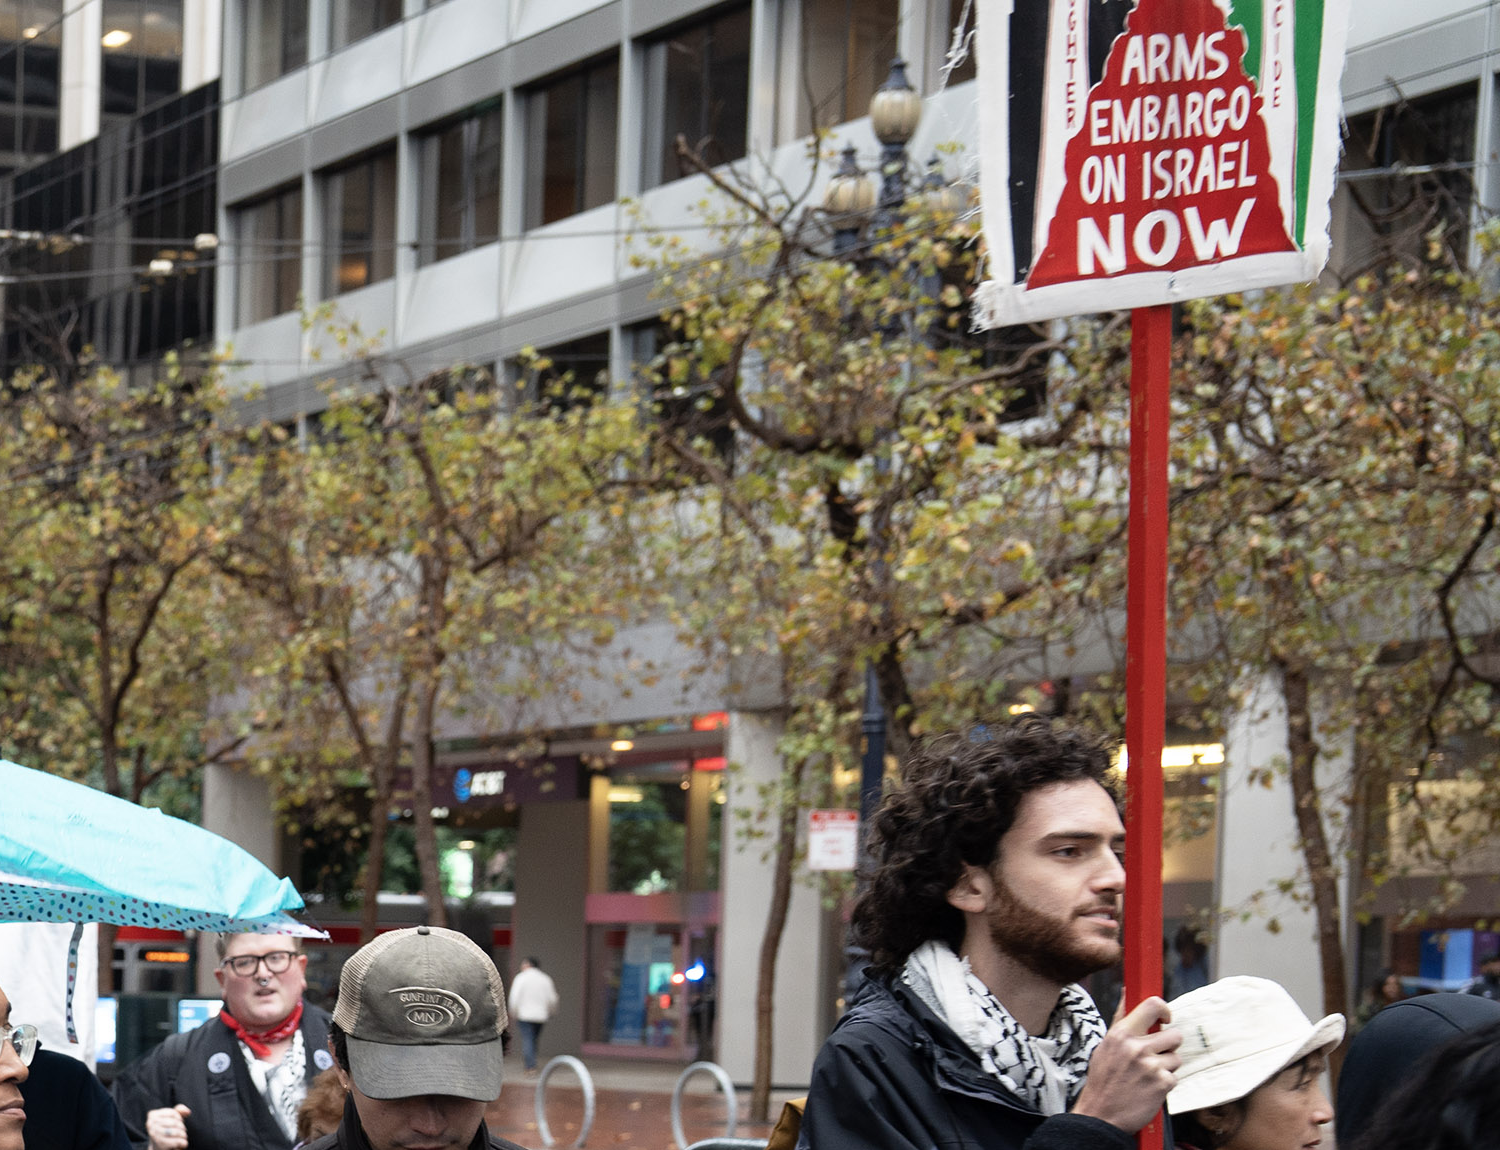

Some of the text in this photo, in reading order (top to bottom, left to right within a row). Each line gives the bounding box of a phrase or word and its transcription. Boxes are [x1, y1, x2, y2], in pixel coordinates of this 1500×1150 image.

[1064, 0, 1079, 131] GHTER
[1120, 31, 1230, 87] ARMS
[1272, 0, 1287, 108] CIDE
[1090, 85, 1251, 147] EMBARGO
[1080, 139, 1257, 205] ON ISRAEL
[1077, 197, 1257, 277] NOW
[400, 991, 465, 1019] GUNFLINT TRAIL
[413, 1011, 437, 1023] MN
